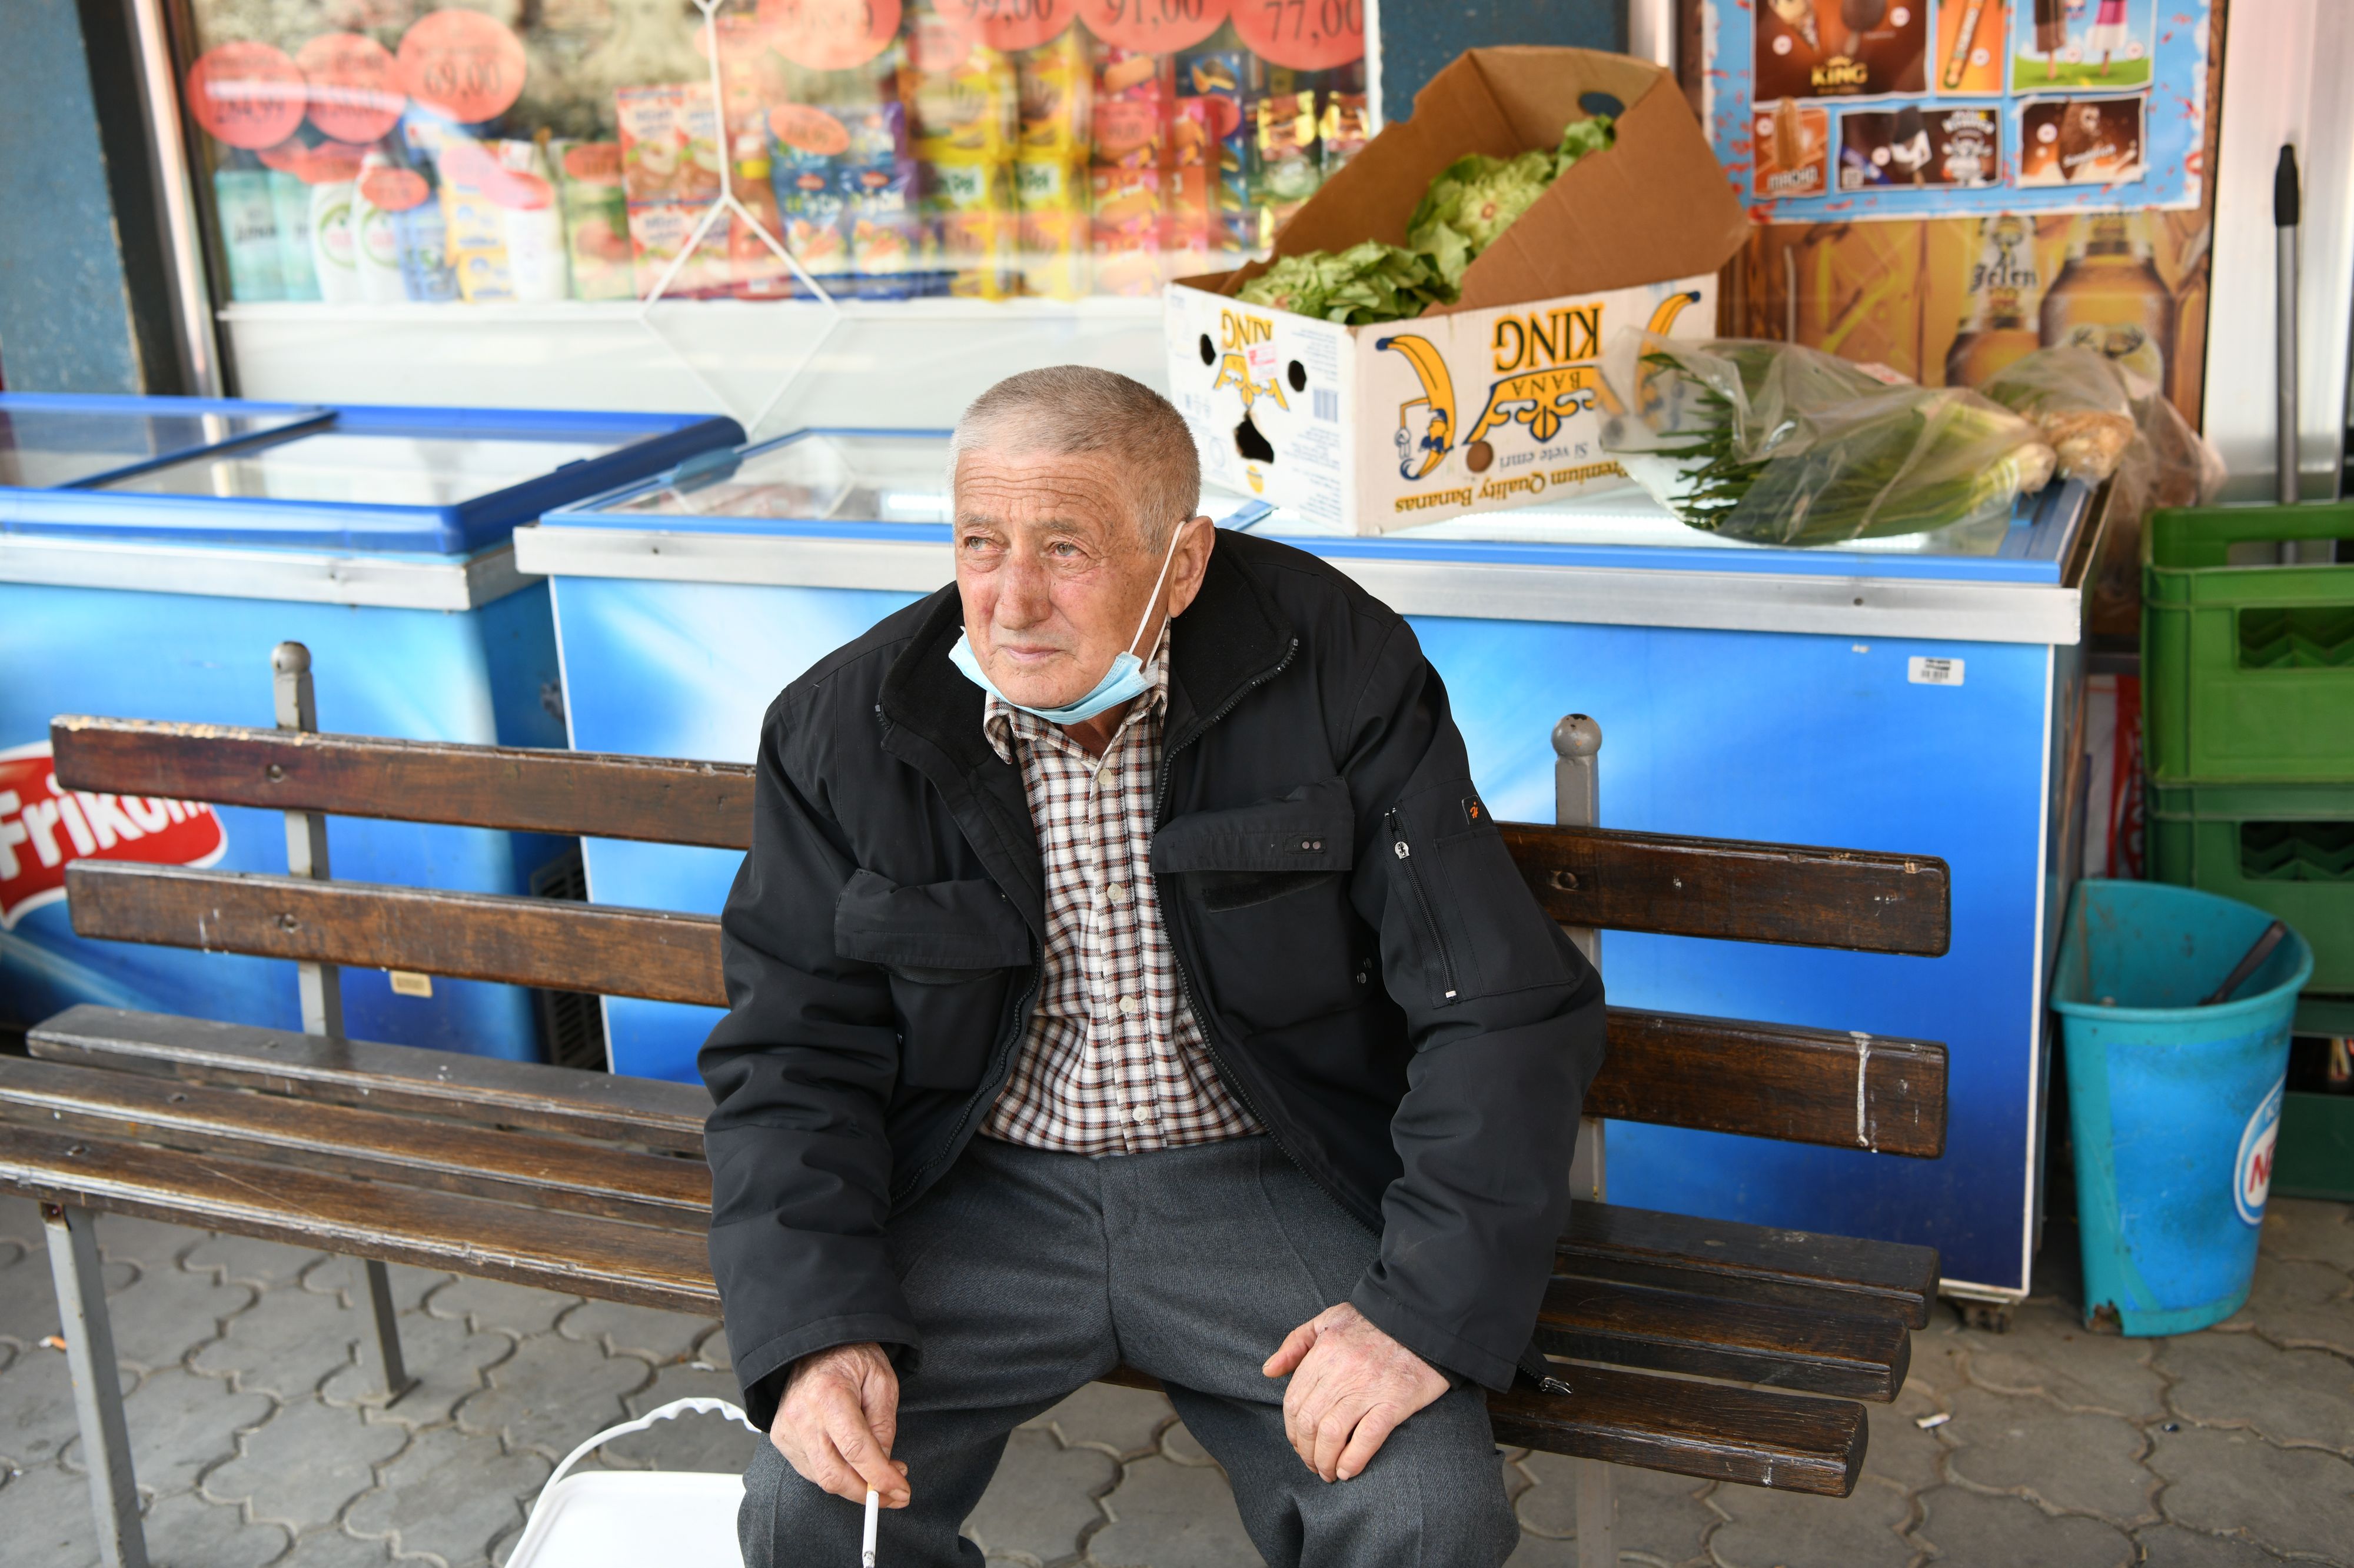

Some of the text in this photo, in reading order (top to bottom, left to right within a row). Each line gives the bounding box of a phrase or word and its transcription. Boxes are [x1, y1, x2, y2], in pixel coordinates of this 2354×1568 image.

[1104, 0, 1203, 31] 91,00
[1265, 0, 1364, 47] 77,00
[1811, 62, 1868, 86] KING
[1969, 250, 2037, 295] Jelen
[1492, 302, 1605, 375] KING
[1511, 371, 1581, 397] BANA
[1395, 486, 1473, 513] Bananas
[1478, 471, 1545, 500] Quality
